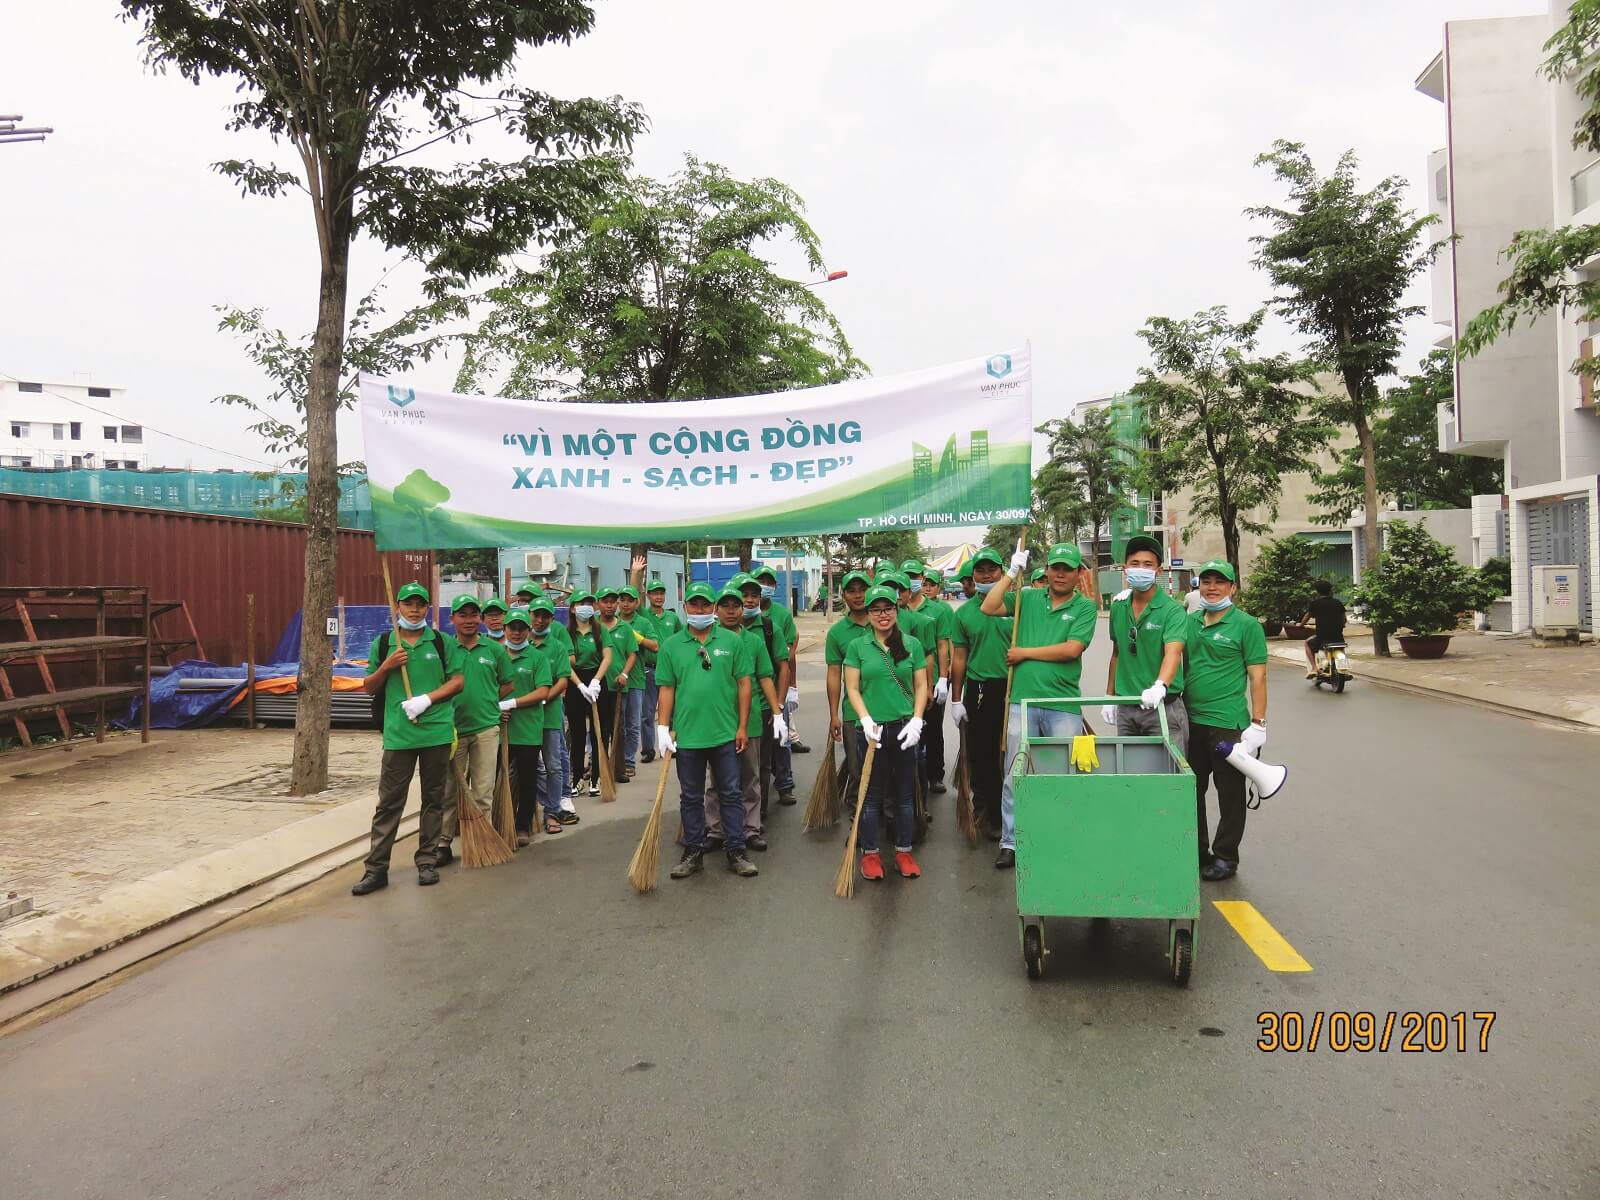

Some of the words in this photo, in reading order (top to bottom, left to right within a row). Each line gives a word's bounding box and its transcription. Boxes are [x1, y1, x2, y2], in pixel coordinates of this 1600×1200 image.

[562, 428, 637, 460] MỘT
[649, 426, 750, 459] CỘNG
[761, 417, 862, 450] ĐỒNG
[512, 467, 610, 489] XANH
[643, 465, 737, 490] SẠCH
[857, 517, 876, 527] TP.
[900, 512, 920, 525] CHÍ
[329, 621, 336, 632] 21
